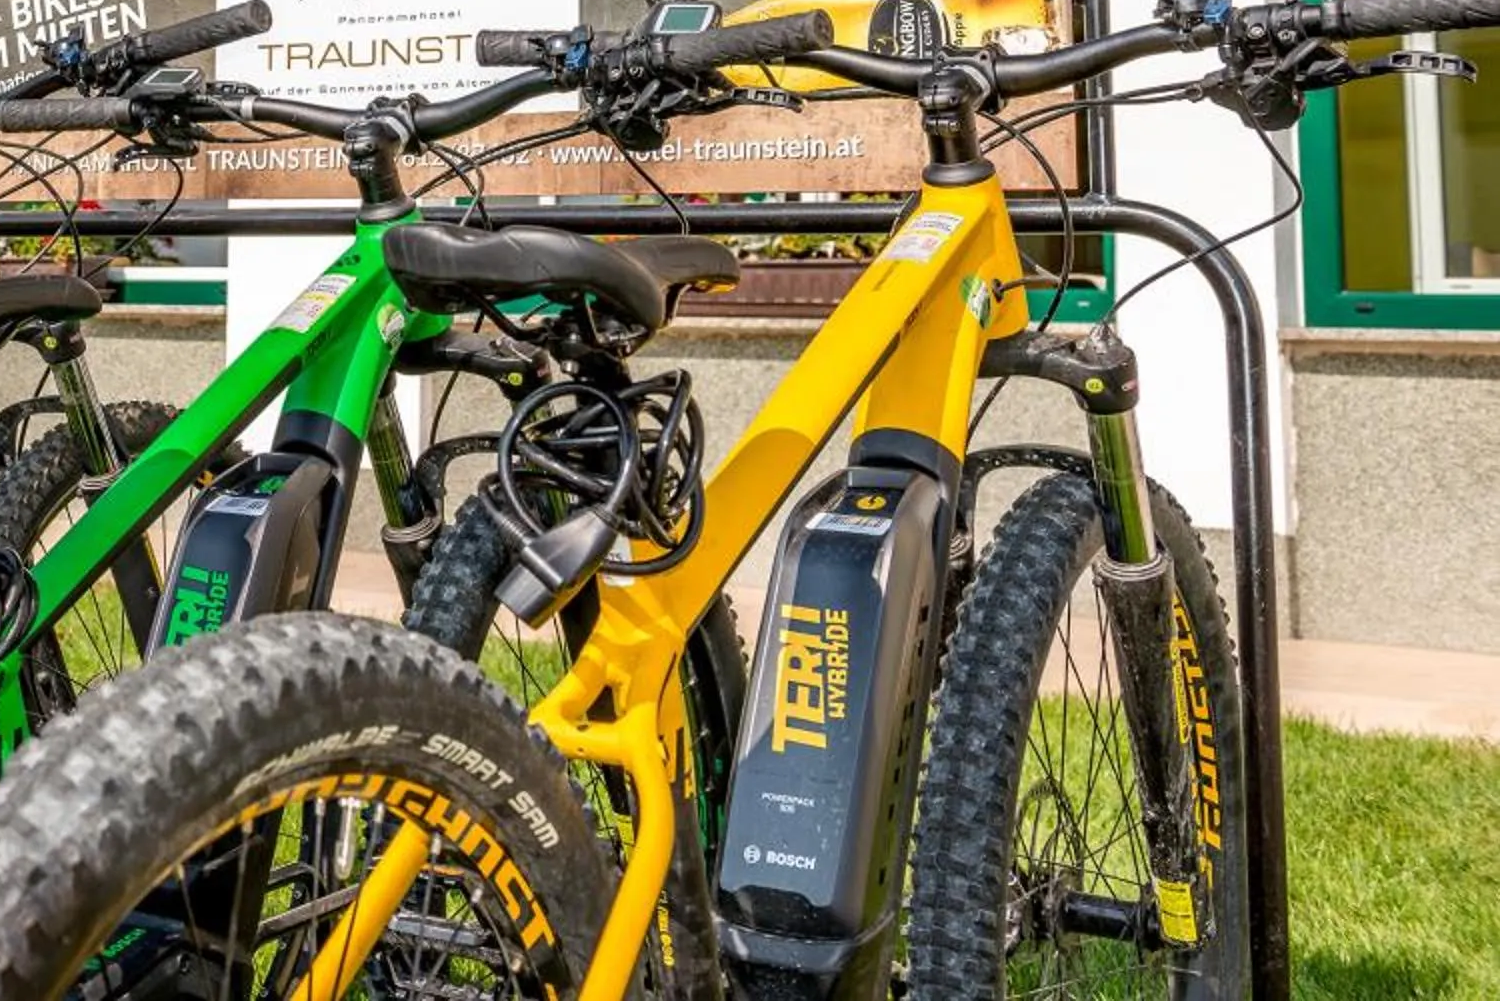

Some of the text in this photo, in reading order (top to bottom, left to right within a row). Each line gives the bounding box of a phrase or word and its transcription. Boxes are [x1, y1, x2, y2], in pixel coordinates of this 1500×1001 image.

[257, 34, 473, 71] TRAUNST
[901, 0, 916, 58] NGBOW
[205, 571, 229, 632] BRIDE
[825, 608, 849, 719] HYBRIDE
[231, 725, 399, 797] SCHWALBE
[420, 732, 514, 790] SMART
[508, 790, 560, 849] SAM
[765, 850, 817, 871] BOSCH
